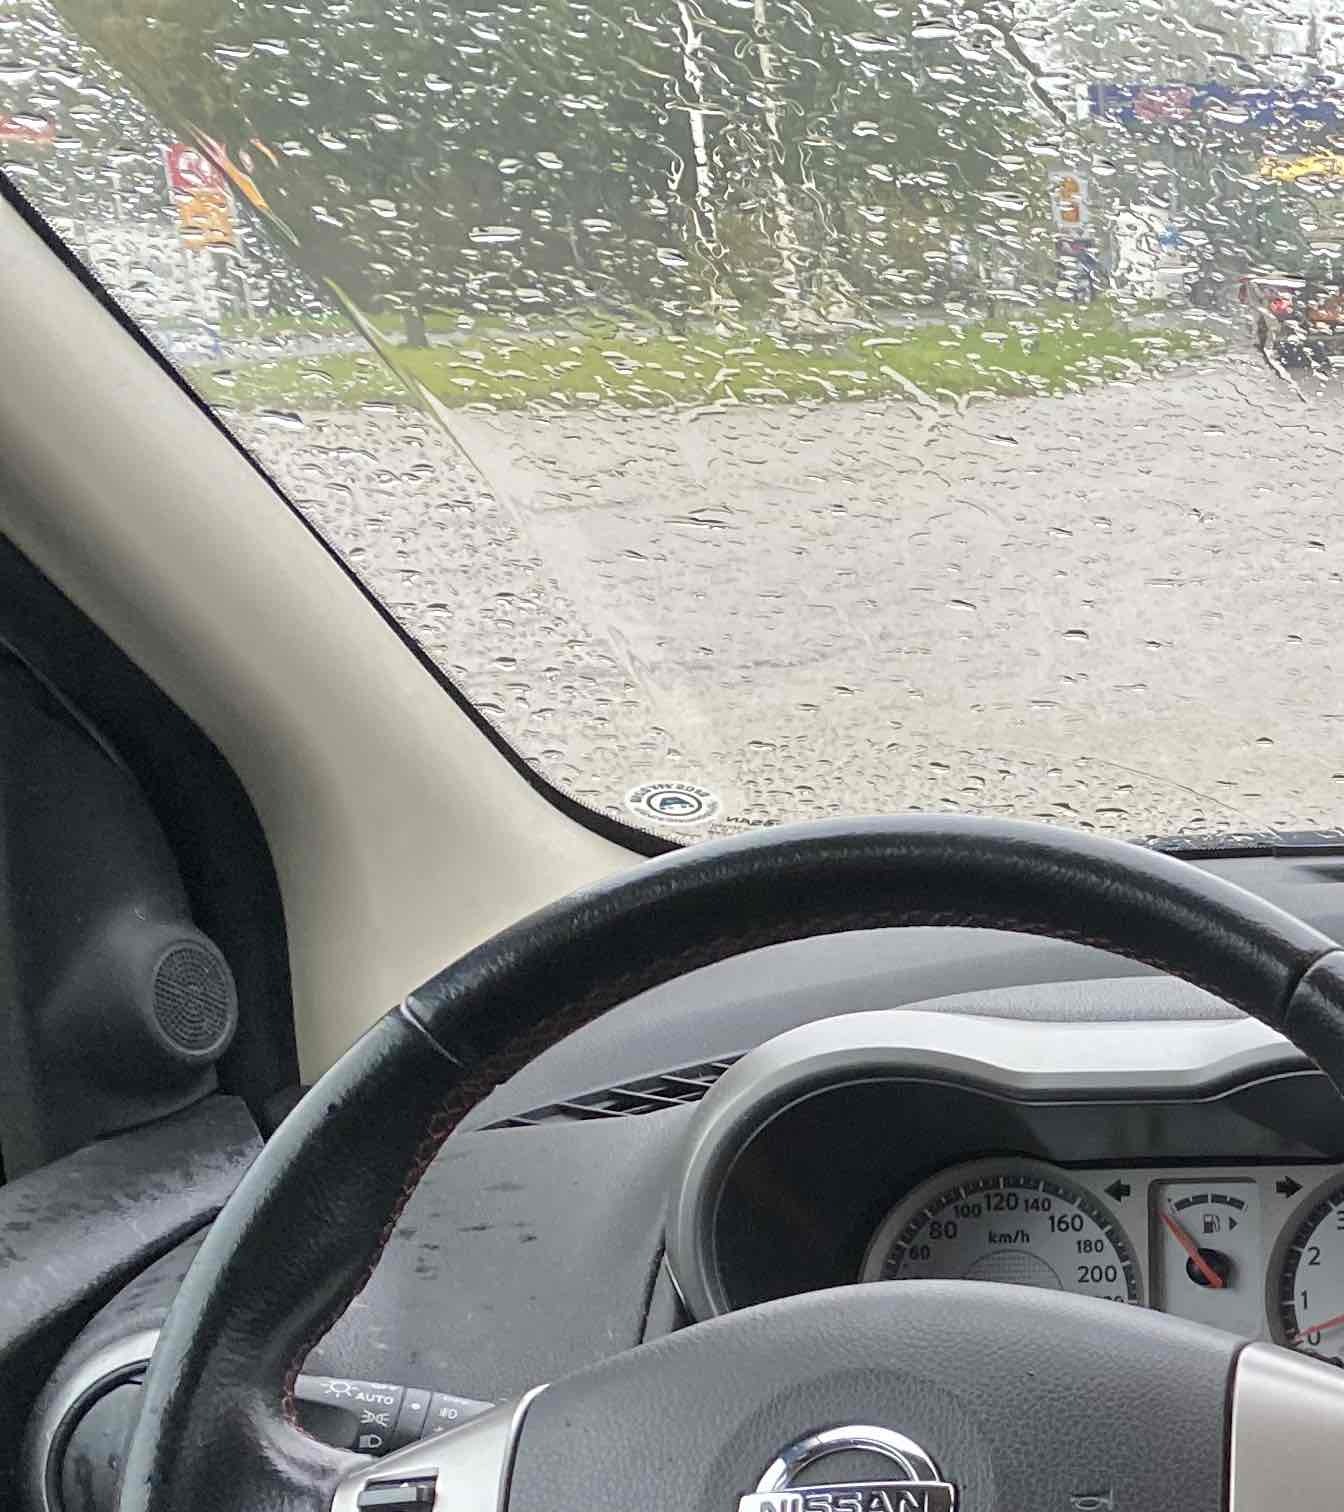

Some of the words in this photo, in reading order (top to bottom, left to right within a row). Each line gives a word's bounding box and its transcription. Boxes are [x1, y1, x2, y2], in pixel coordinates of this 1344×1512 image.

[986, 1193, 1018, 1211] 120
[1024, 1198, 1051, 1212] 140
[954, 1204, 981, 1218] 100
[929, 1221, 957, 1239] 80
[1049, 1215, 1083, 1232] 160
[988, 1230, 1030, 1244] km/h
[909, 1246, 930, 1260] 60
[1076, 1240, 1104, 1253] 180
[1308, 1247, 1320, 1265] 2
[1077, 1266, 1117, 1282] 200
[1301, 1291, 1308, 1309] 1
[354, 1392, 394, 1405] AUTO
